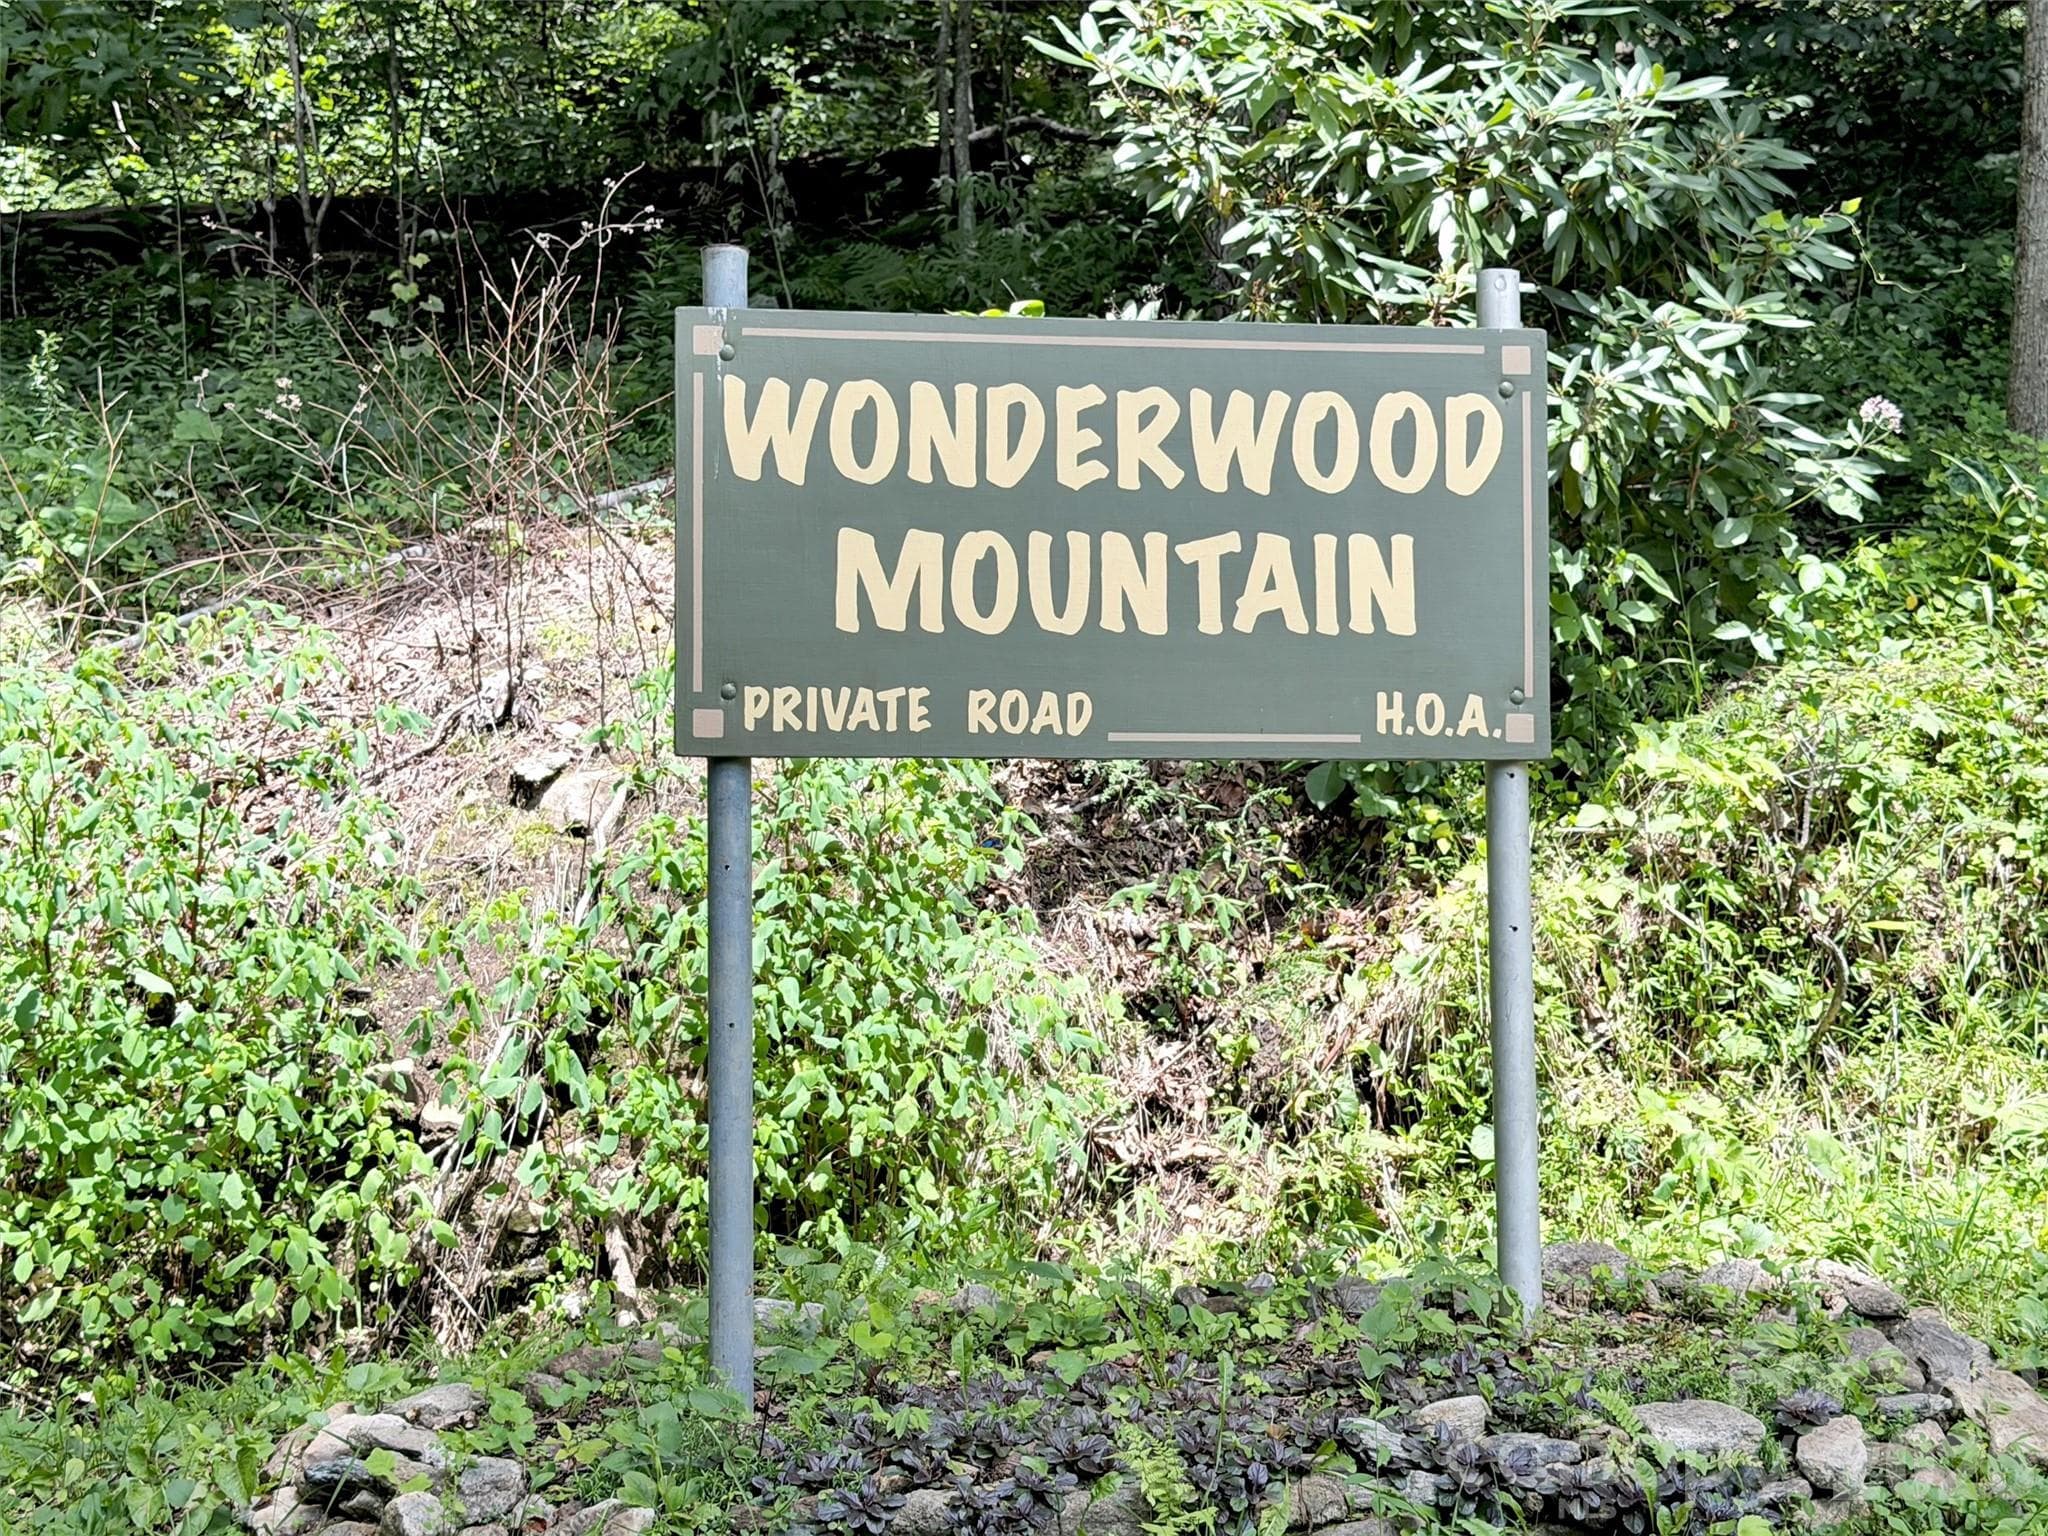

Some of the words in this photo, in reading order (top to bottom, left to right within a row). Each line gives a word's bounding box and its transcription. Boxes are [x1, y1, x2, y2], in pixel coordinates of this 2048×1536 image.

[723, 375, 1503, 496] WONDERWOOD
[834, 527, 1417, 636] MOUNTAIN
[742, 686, 931, 733] PRIVATE
[967, 689, 1093, 737] ROAD
[1375, 690, 1502, 739] H.O.A.
